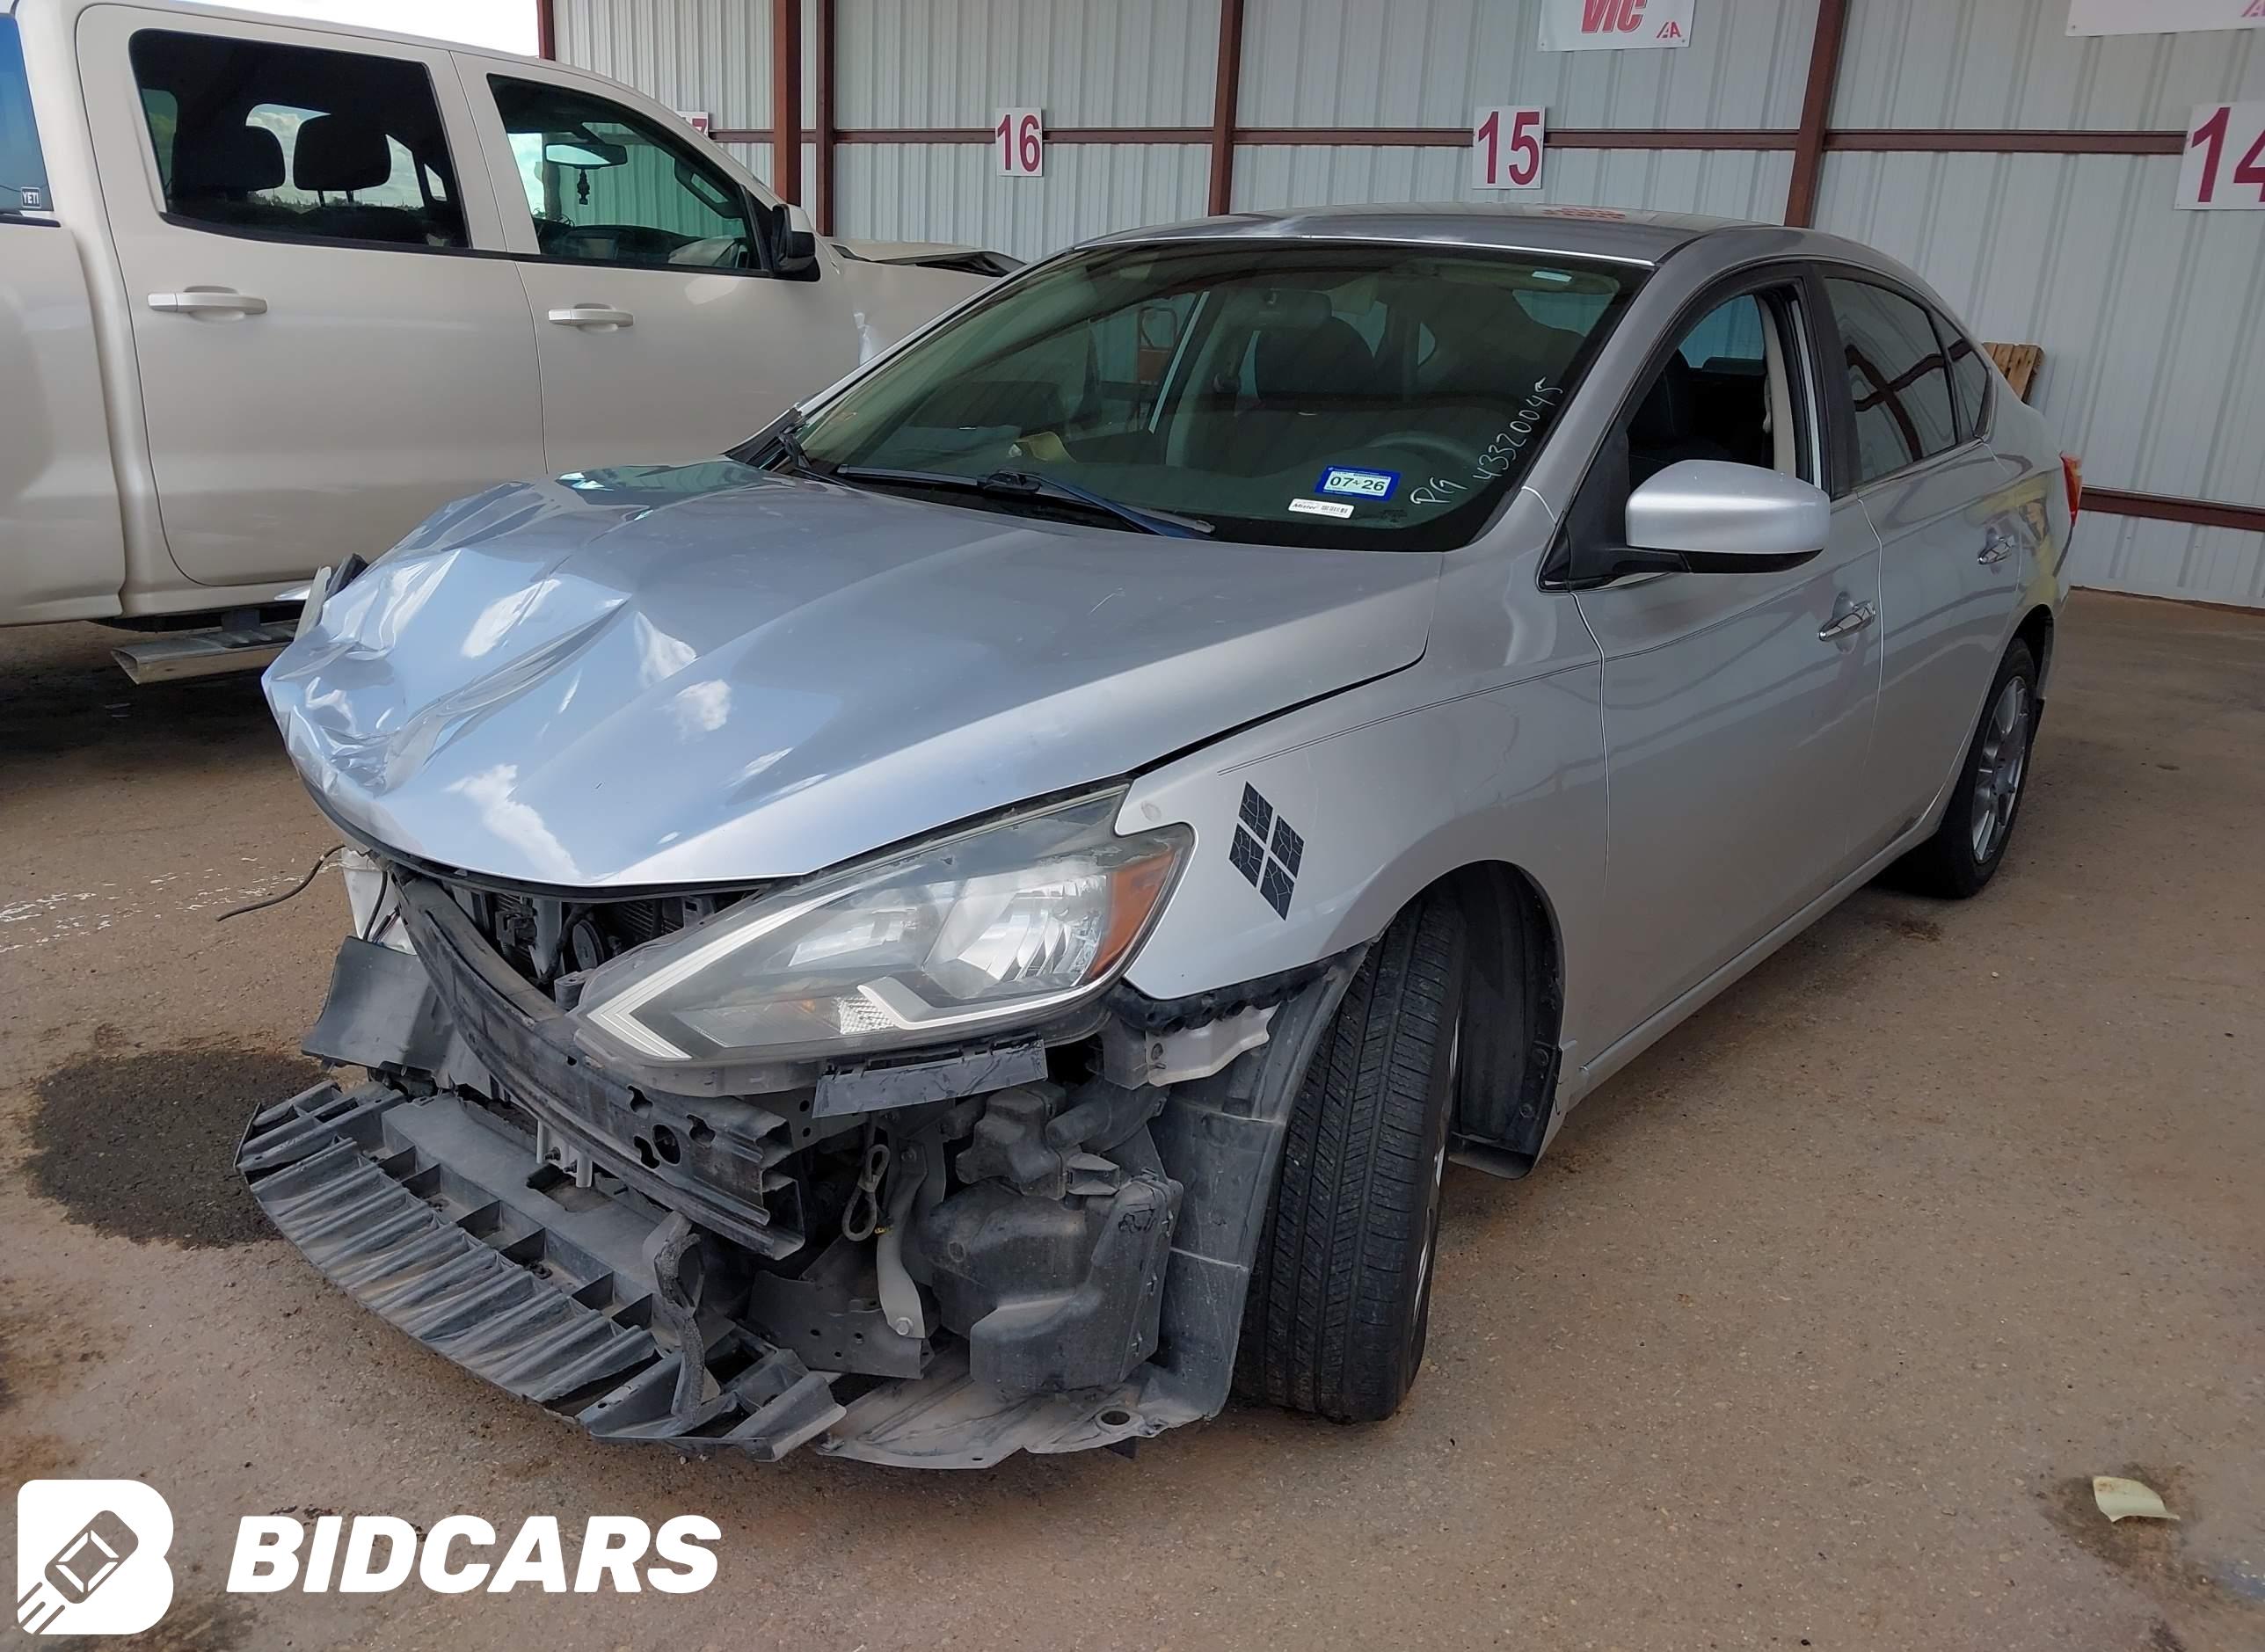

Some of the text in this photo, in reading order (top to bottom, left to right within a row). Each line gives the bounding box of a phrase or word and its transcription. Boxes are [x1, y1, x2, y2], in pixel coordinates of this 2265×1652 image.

[997, 113, 1041, 172] 16
[1478, 111, 1540, 186] 15
[22, 191, 40, 205] YETI
[1471, 376, 1563, 480] 43320045
[1329, 476, 1355, 488] 07
[1360, 478, 1387, 492] 26
